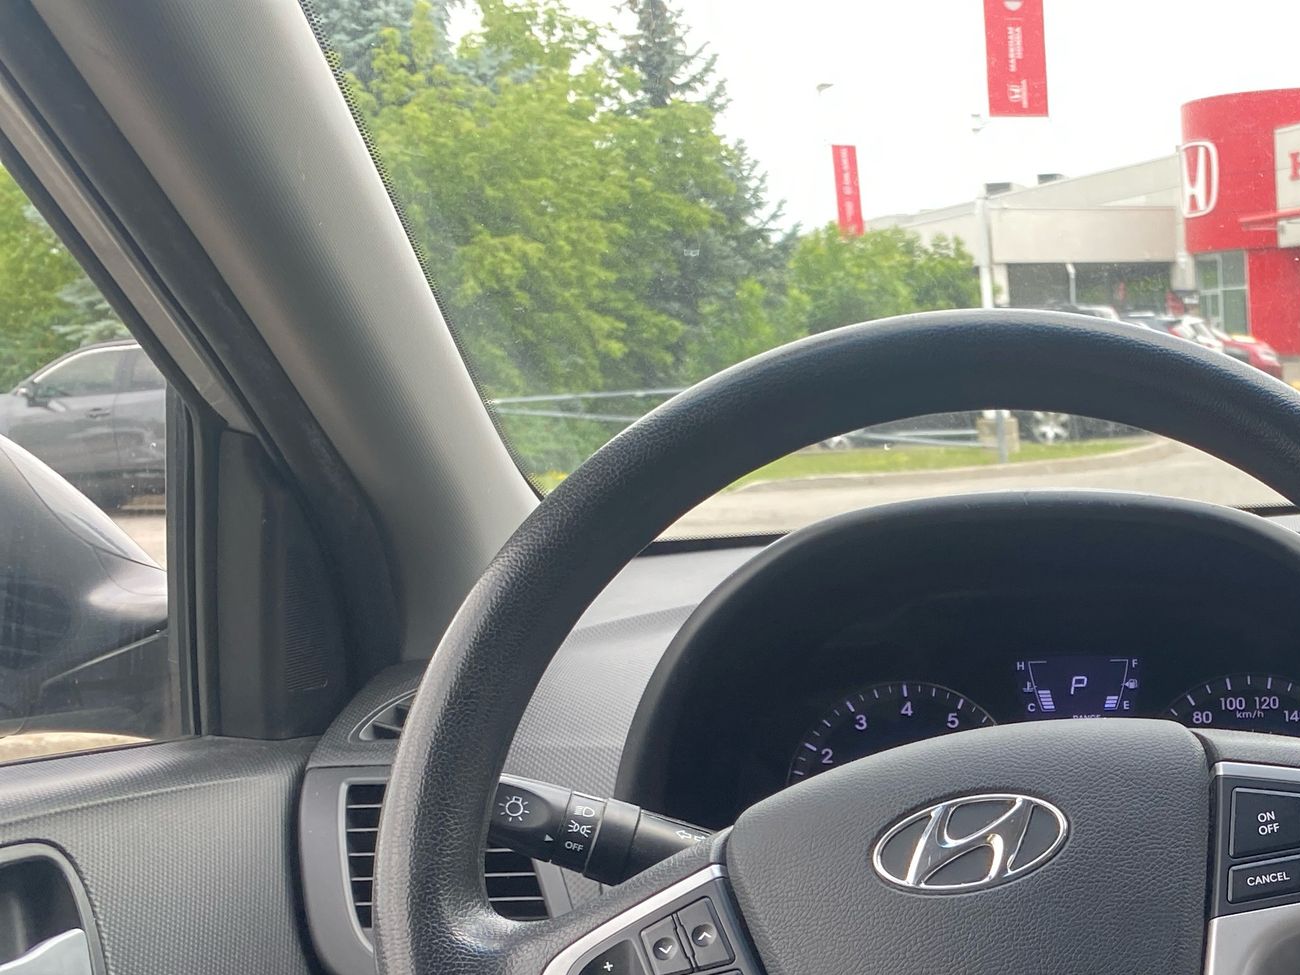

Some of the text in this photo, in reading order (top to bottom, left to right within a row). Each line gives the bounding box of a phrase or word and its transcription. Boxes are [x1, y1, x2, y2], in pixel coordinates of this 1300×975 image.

[1016, 661, 1025, 671] H
[1132, 659, 1138, 668] F
[1070, 675, 1088, 695] P
[900, 701, 913, 716] 4
[1027, 703, 1036, 712] C
[1123, 700, 1130, 710] E
[1219, 697, 1246, 711] 100
[1254, 696, 1279, 709] 120
[946, 712, 960, 728] 5
[1192, 710, 1213, 724] 80
[1236, 710, 1264, 719] km/h
[855, 714, 868, 730] 3
[821, 748, 833, 764] 2
[1257, 811, 1276, 823] ON
[1258, 823, 1280, 835] OFF
[564, 841, 584, 852] OFF
[1246, 872, 1291, 886] CANCEL
